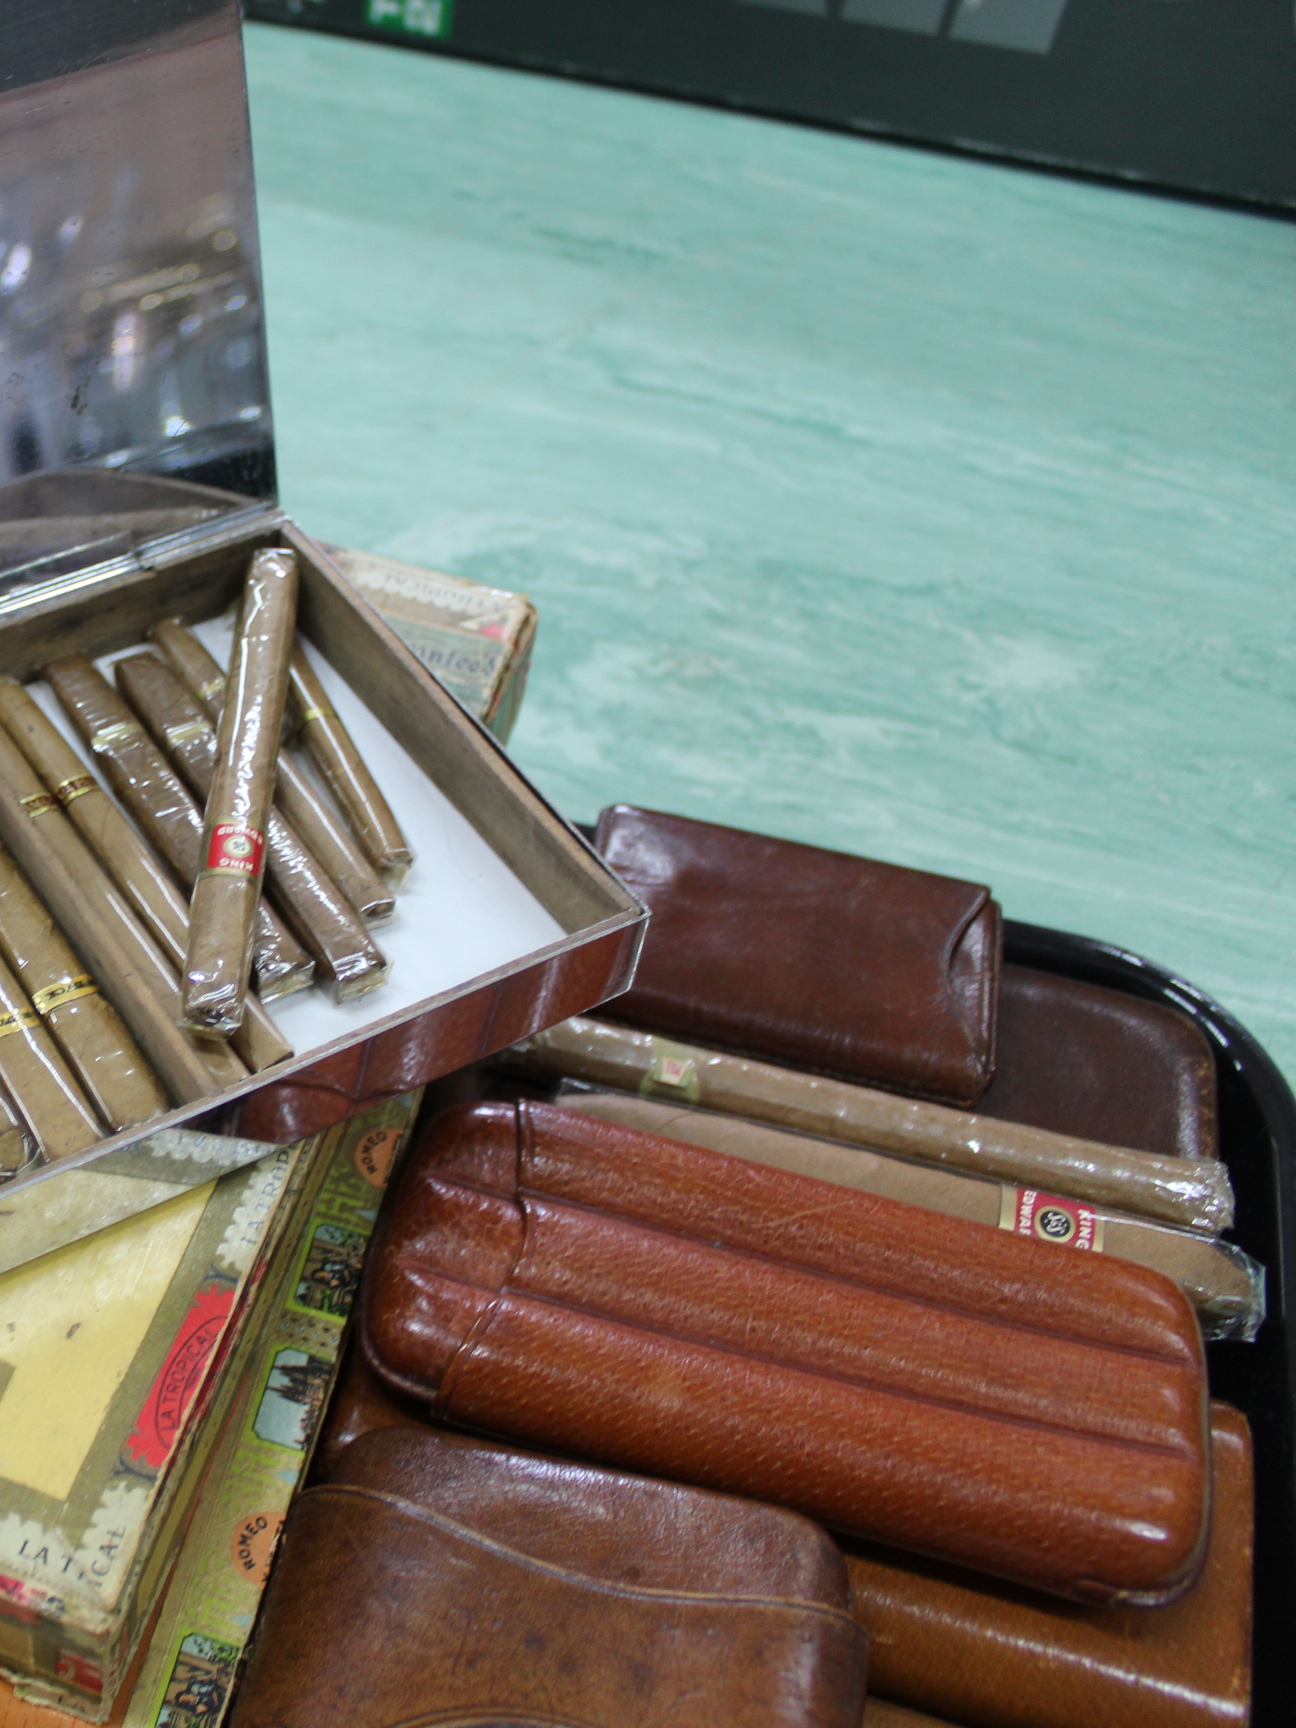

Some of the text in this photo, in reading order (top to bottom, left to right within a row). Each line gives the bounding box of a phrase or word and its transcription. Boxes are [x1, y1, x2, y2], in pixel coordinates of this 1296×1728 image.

[219, 857, 254, 872] KING
[360, 1128, 387, 1175] ROMEO
[1074, 1208, 1092, 1250] KING
[161, 1328, 218, 1407] TROPICAL
[160, 1409, 177, 1431] LA
[18, 1539, 50, 1565] LA
[237, 1516, 268, 1571] ROMEO
